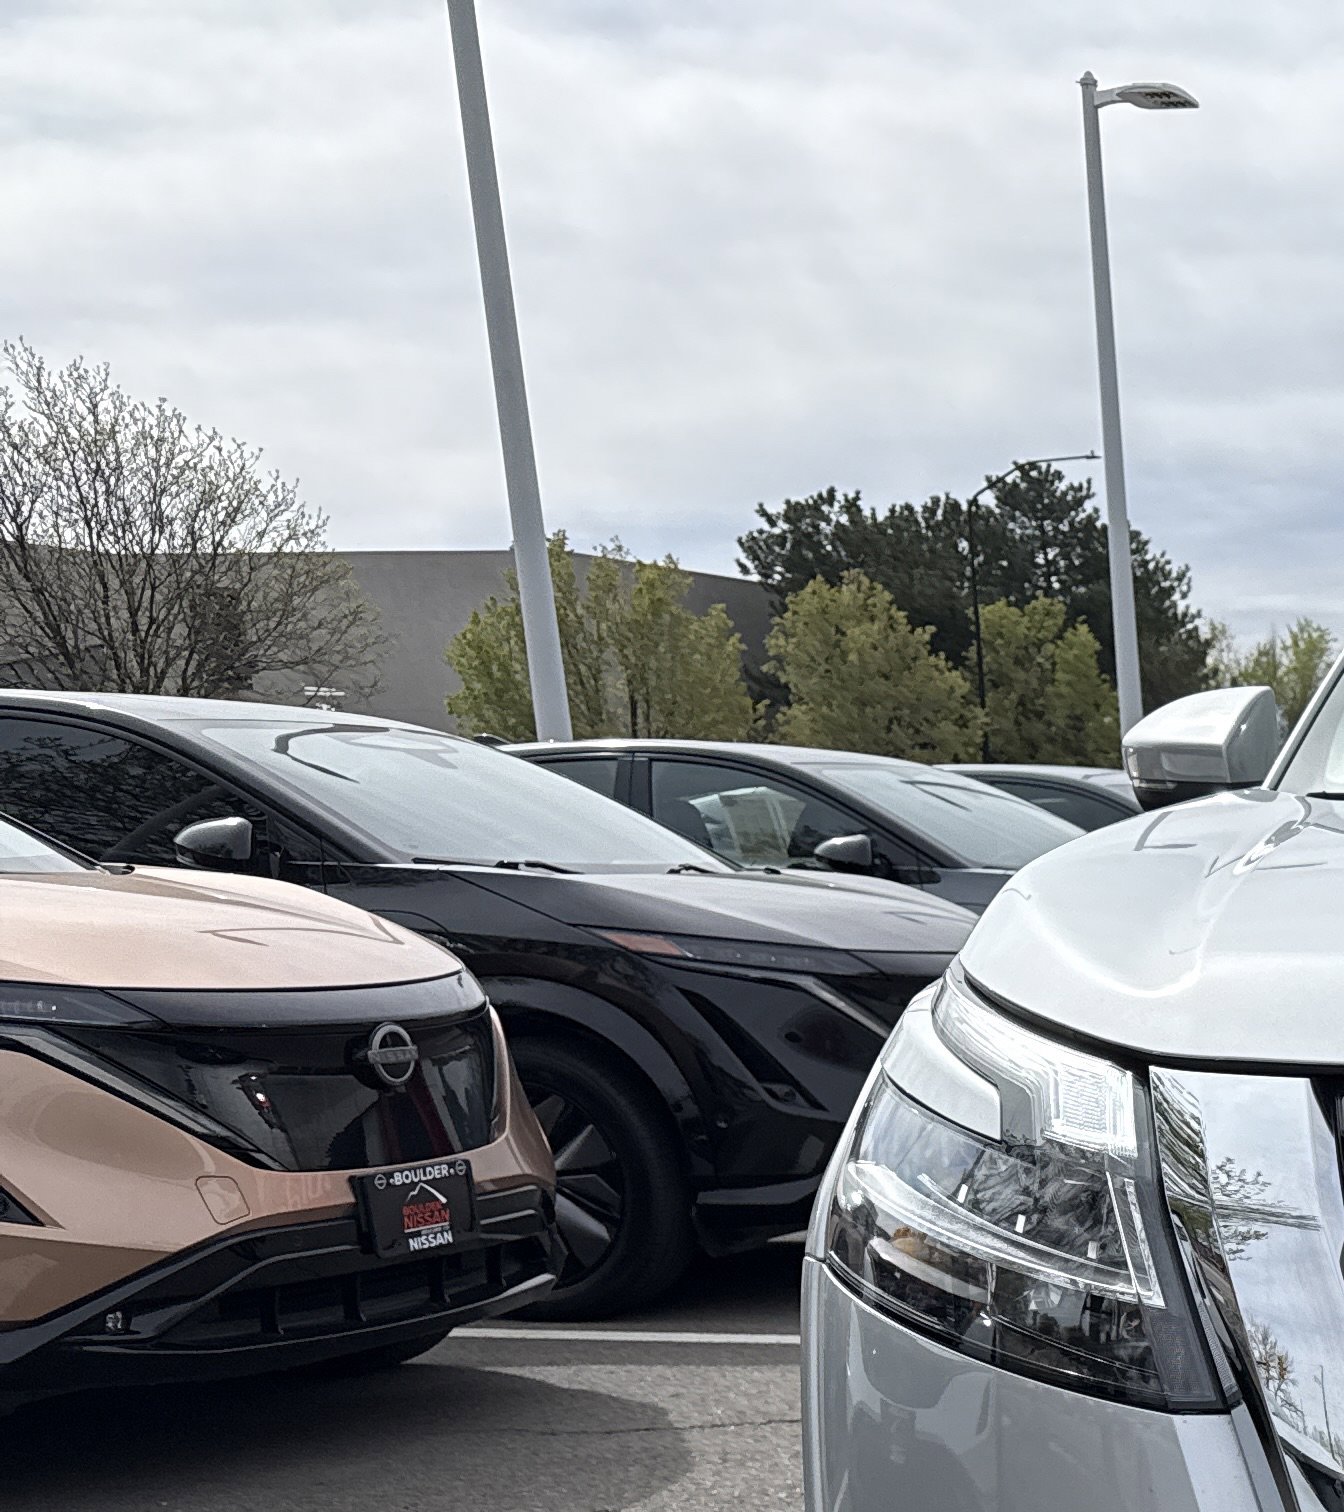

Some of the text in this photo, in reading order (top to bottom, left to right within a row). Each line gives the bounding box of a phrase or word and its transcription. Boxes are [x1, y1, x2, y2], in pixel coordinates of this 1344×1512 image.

[393, 1164, 449, 1186] BOULDER
[404, 1208, 450, 1229] NISSAN
[408, 1230, 454, 1252] NISSAN
